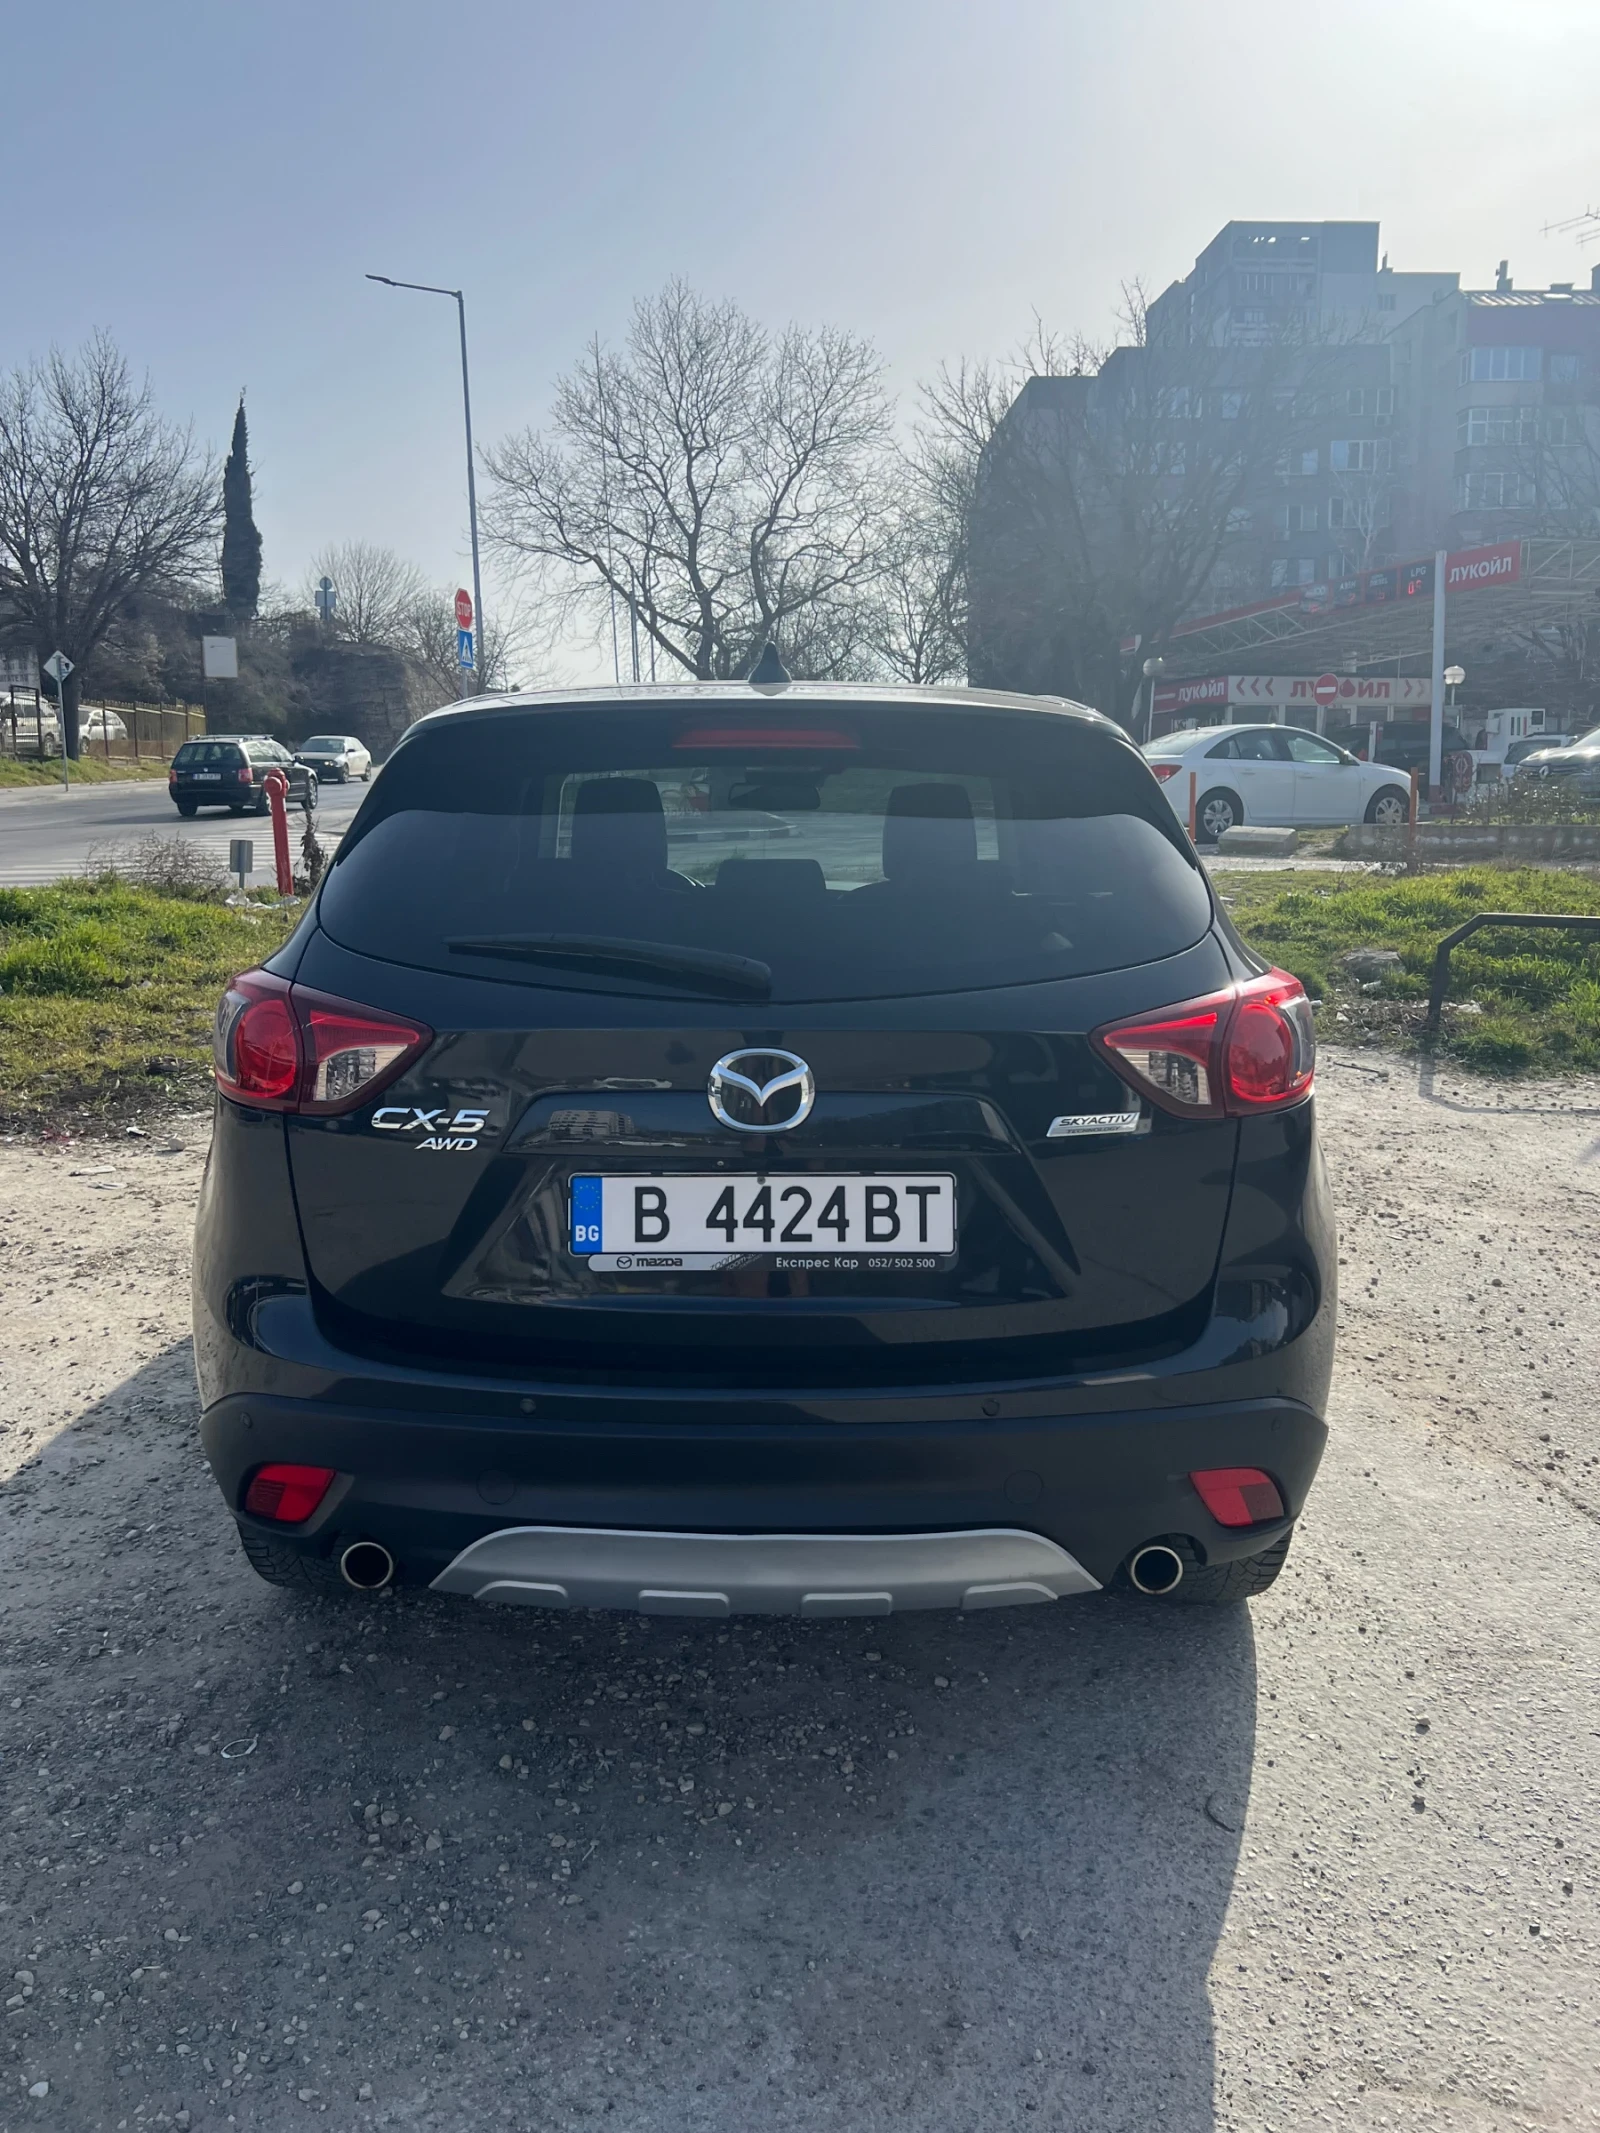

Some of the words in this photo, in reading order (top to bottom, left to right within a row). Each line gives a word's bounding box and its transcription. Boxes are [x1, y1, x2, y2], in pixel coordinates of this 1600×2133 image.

[1410, 566, 1426, 577] LPG
[1449, 555, 1512, 583] ЛУКОЙЛ
[457, 601, 471, 617] STOP
[371, 1107, 490, 1133] CX-5
[1059, 1114, 1131, 1126] SKYACTIV
[414, 1137, 478, 1151] AWD
[575, 1225, 599, 1242] BG
[776, 1257, 830, 1270] Експрес
[834, 1257, 859, 1270] Кар
[895, 1258, 914, 1268] 502
[916, 1258, 936, 1268] 500
